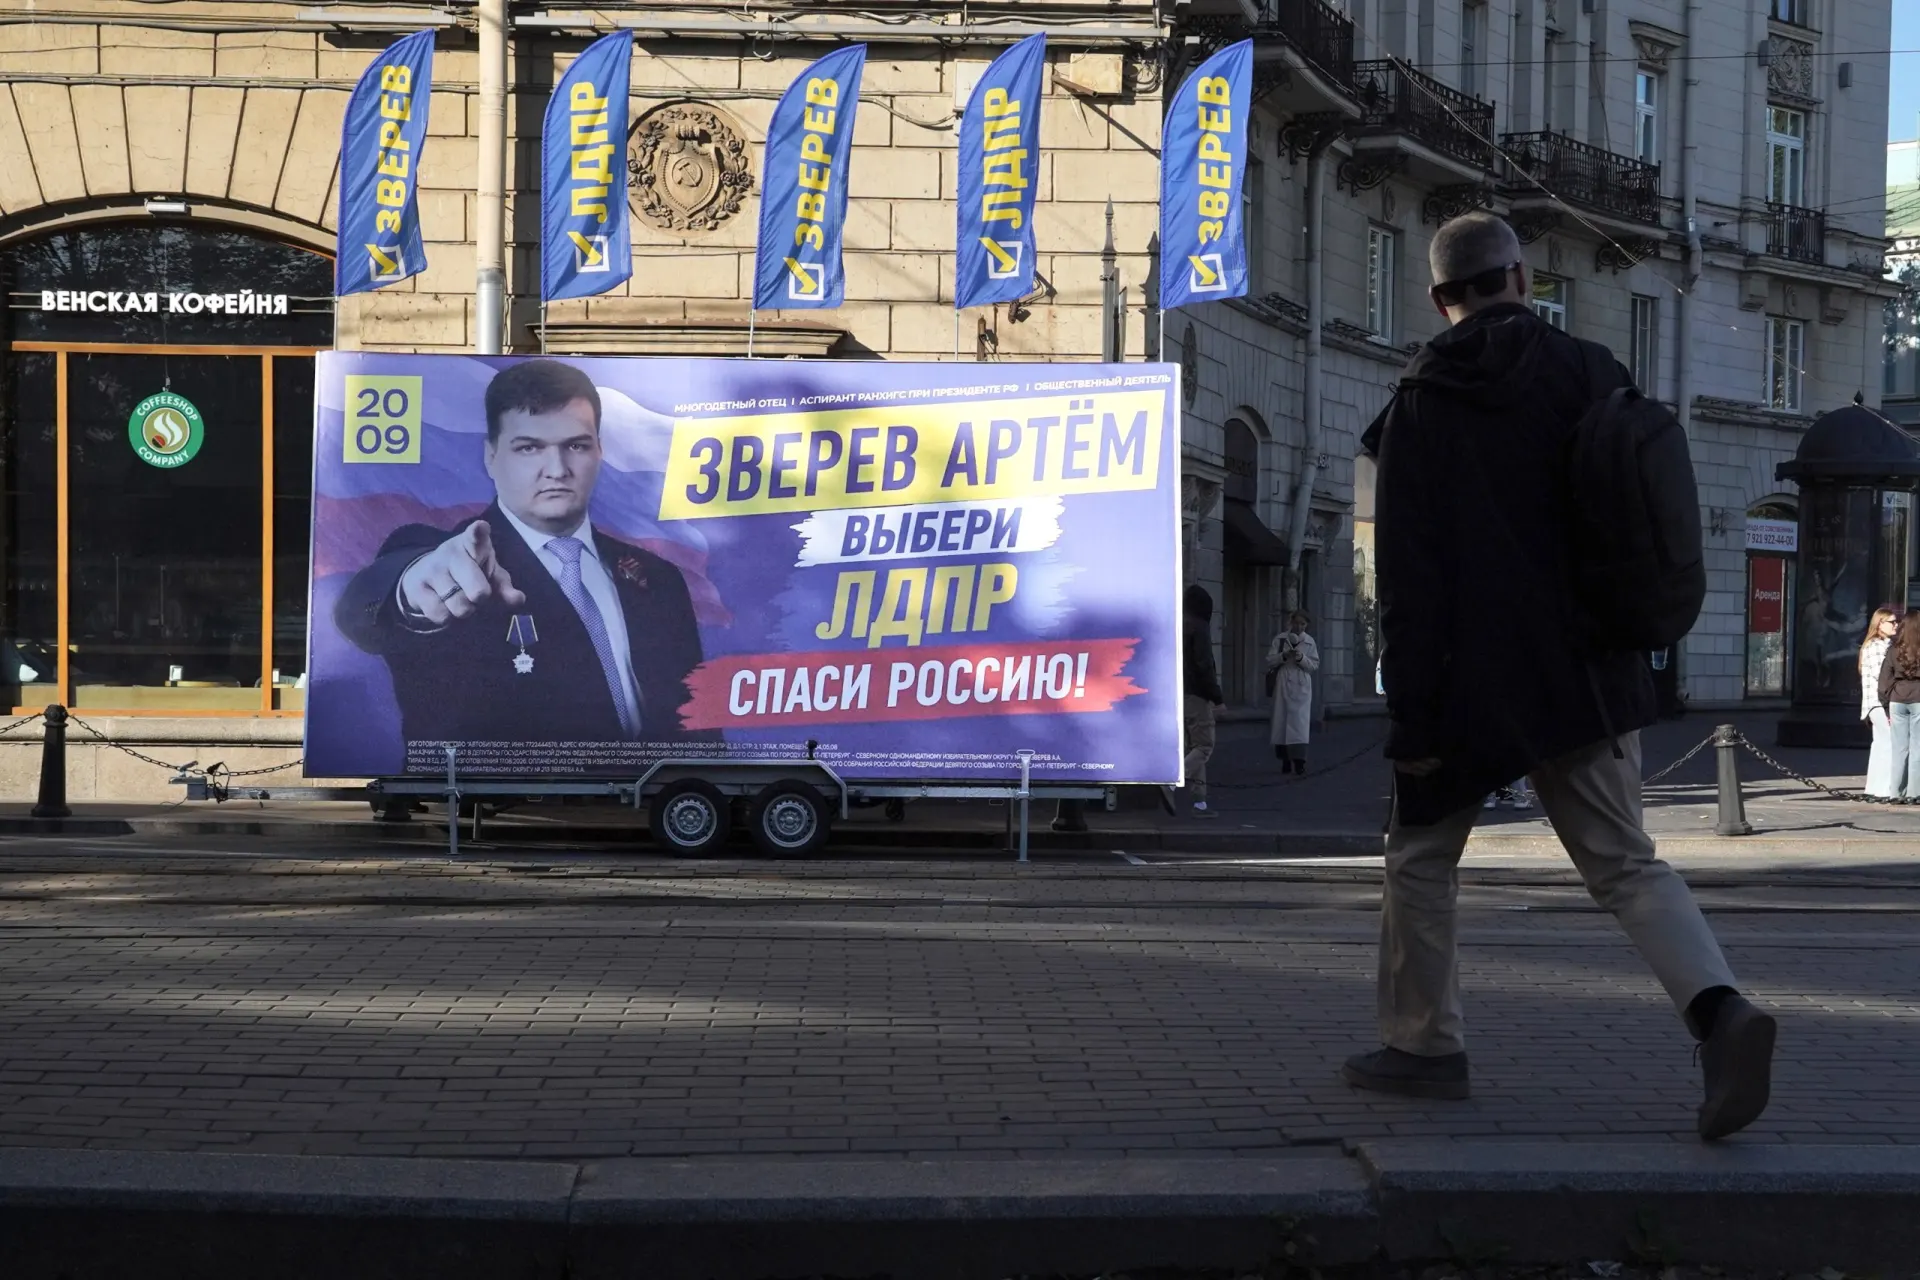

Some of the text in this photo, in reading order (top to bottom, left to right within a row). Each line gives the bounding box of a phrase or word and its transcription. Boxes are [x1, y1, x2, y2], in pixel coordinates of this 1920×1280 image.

[375, 64, 412, 235] ЗВЕРЕВ
[570, 81, 615, 224] ЛДПР
[794, 77, 839, 251] ЗВЕРЕВ
[982, 87, 1028, 230] ЛДПР
[1197, 76, 1231, 245] ЗВЕРЕВ
[41, 288, 288, 315] ВЕНСКАЯ КОФЕЙНЯ
[136, 395, 198, 421] COFFEESHOP
[356, 388, 409, 418] 20
[674, 399, 755, 413] МНОГОДЕТНЫЙ
[758, 398, 787, 409] ОТЕЦ
[799, 393, 857, 405] АСПИРАНТ
[858, 391, 906, 401] РАНХИГС
[908, 388, 930, 398] ПРИ
[932, 385, 1001, 397] ПРЕЗИДЕНТЕ
[1003, 384, 1019, 394] РФ
[1034, 376, 1122, 391] ОБЩЕСТВЕННЫЙ
[1123, 374, 1171, 387] ДЕЯТЕЛЬ
[138, 446, 189, 466] COMPANY
[356, 424, 410, 454] 09
[686, 399, 1148, 504] ЗВЕРЕВ АРТЁМ
[840, 507, 1023, 557] ВЫБЕРИ
[815, 563, 1018, 648] ЛДПР
[1754, 588, 1780, 602] Аренда
[728, 652, 1089, 716] СПАСИ РОССИЮ!
[501, 749, 554, 757] ГОСУДАРСТВЕННОЙ
[646, 750, 683, 758] РОССИЙСКОЙ
[672, 742, 717, 750] МИХАЙЛОВСКИЙ
[873, 760, 910, 768] РОССИЙСКОЙ
